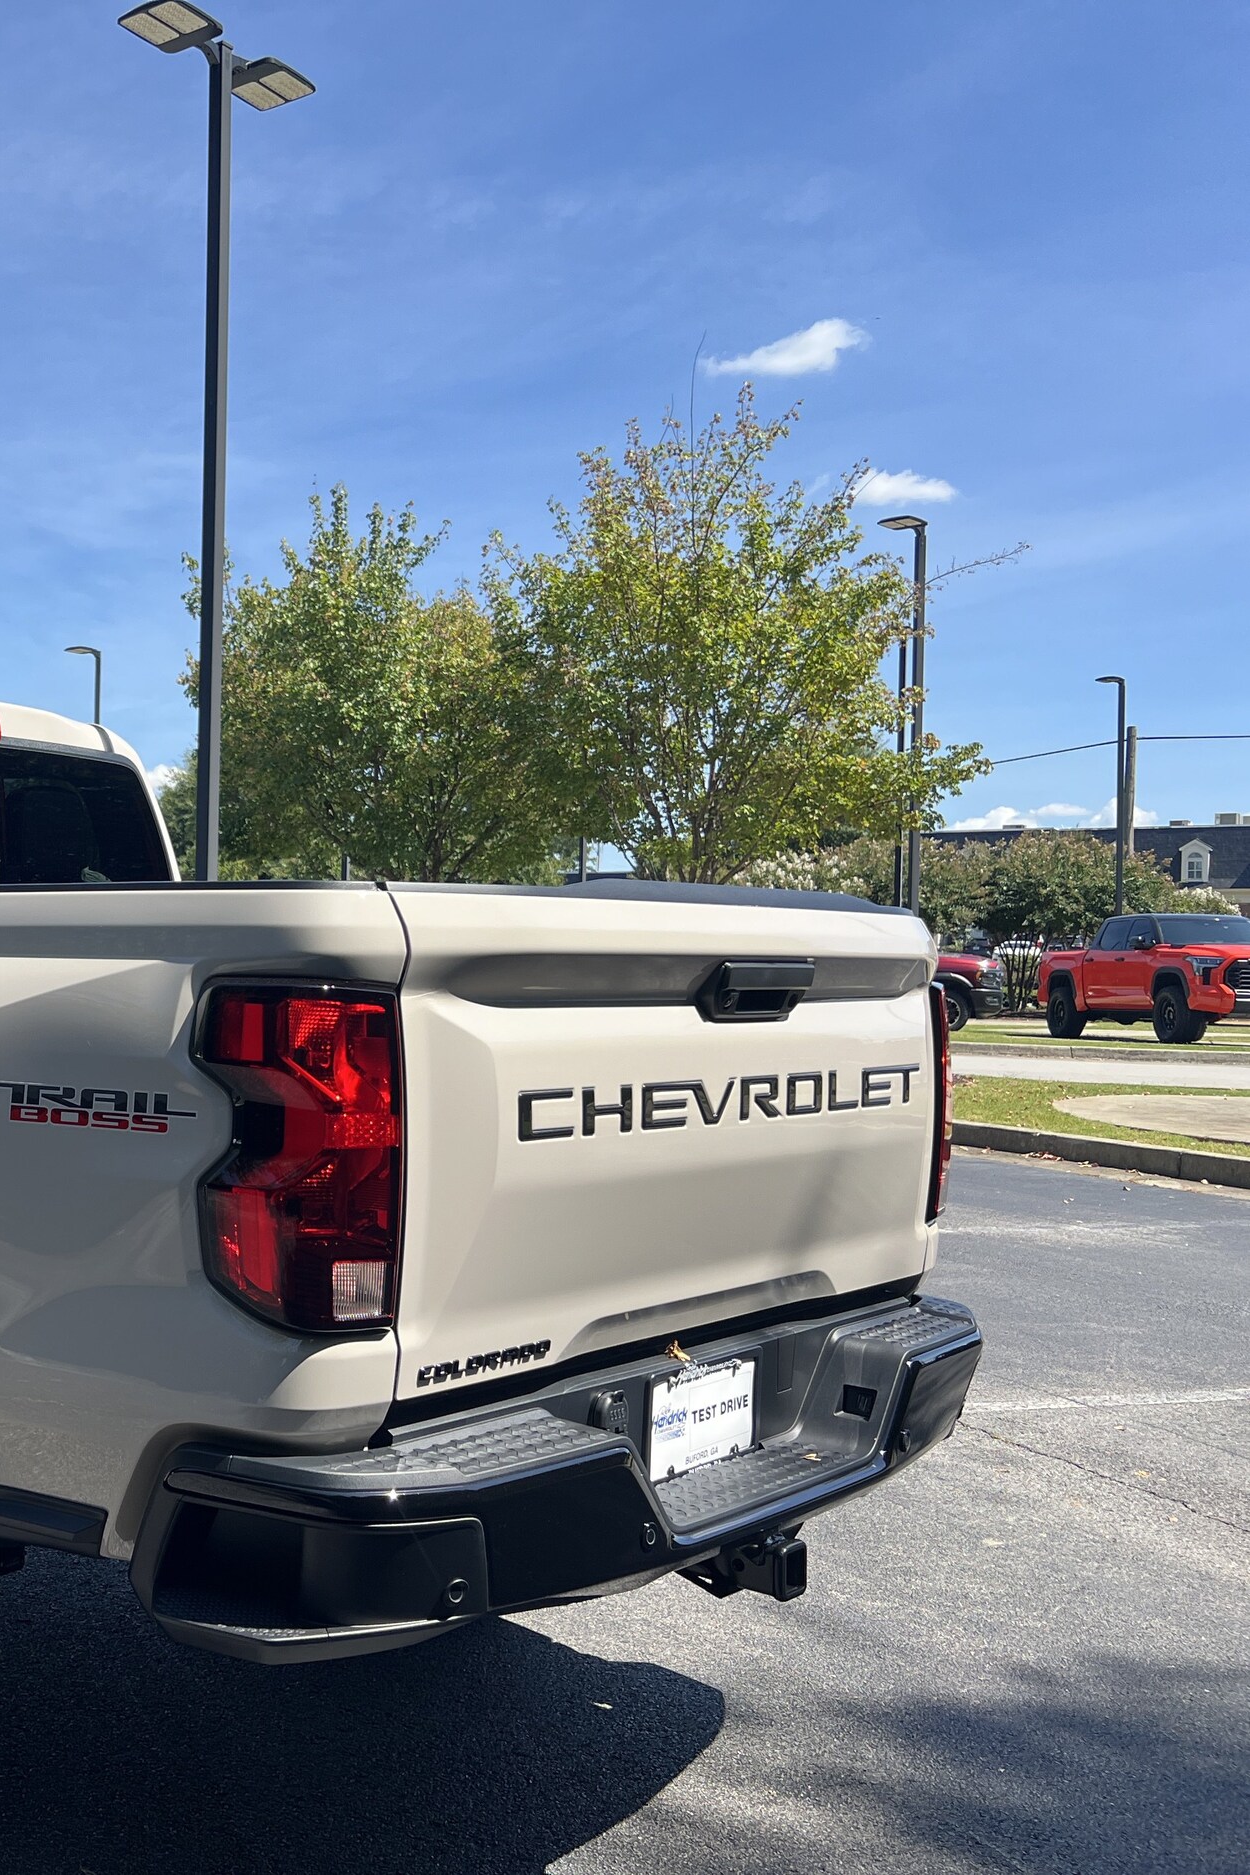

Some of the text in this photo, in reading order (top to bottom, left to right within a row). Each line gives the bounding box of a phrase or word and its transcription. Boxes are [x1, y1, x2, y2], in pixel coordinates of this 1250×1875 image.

[517, 1062, 921, 1142] CHEVROLET
[9, 1105, 170, 1134] BOSS
[417, 1339, 551, 1388] COLORADO
[652, 1407, 688, 1434] Hendrick
[692, 1394, 749, 1424] TEST DRIVE
[710, 1446, 719, 1456] GA
